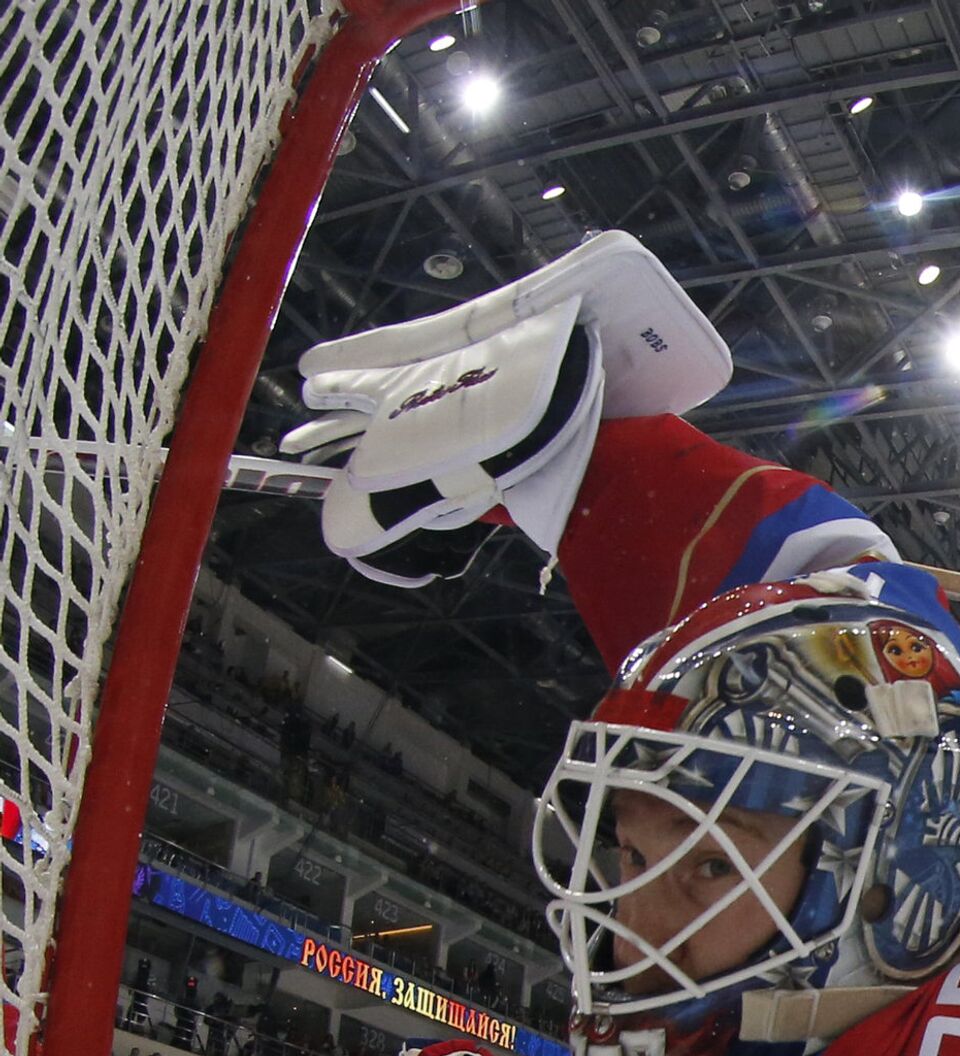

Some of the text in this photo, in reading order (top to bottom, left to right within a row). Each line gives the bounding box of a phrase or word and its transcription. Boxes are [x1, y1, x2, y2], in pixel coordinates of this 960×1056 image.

[640, 327, 668, 352] BOBS
[150, 783, 178, 815] 421
[294, 860, 323, 886] 422
[374, 899, 398, 923] 423
[301, 938, 517, 1051] РОССИЯ, ЗАЩИЩАЙСЯ!
[360, 1026, 386, 1051] 328
